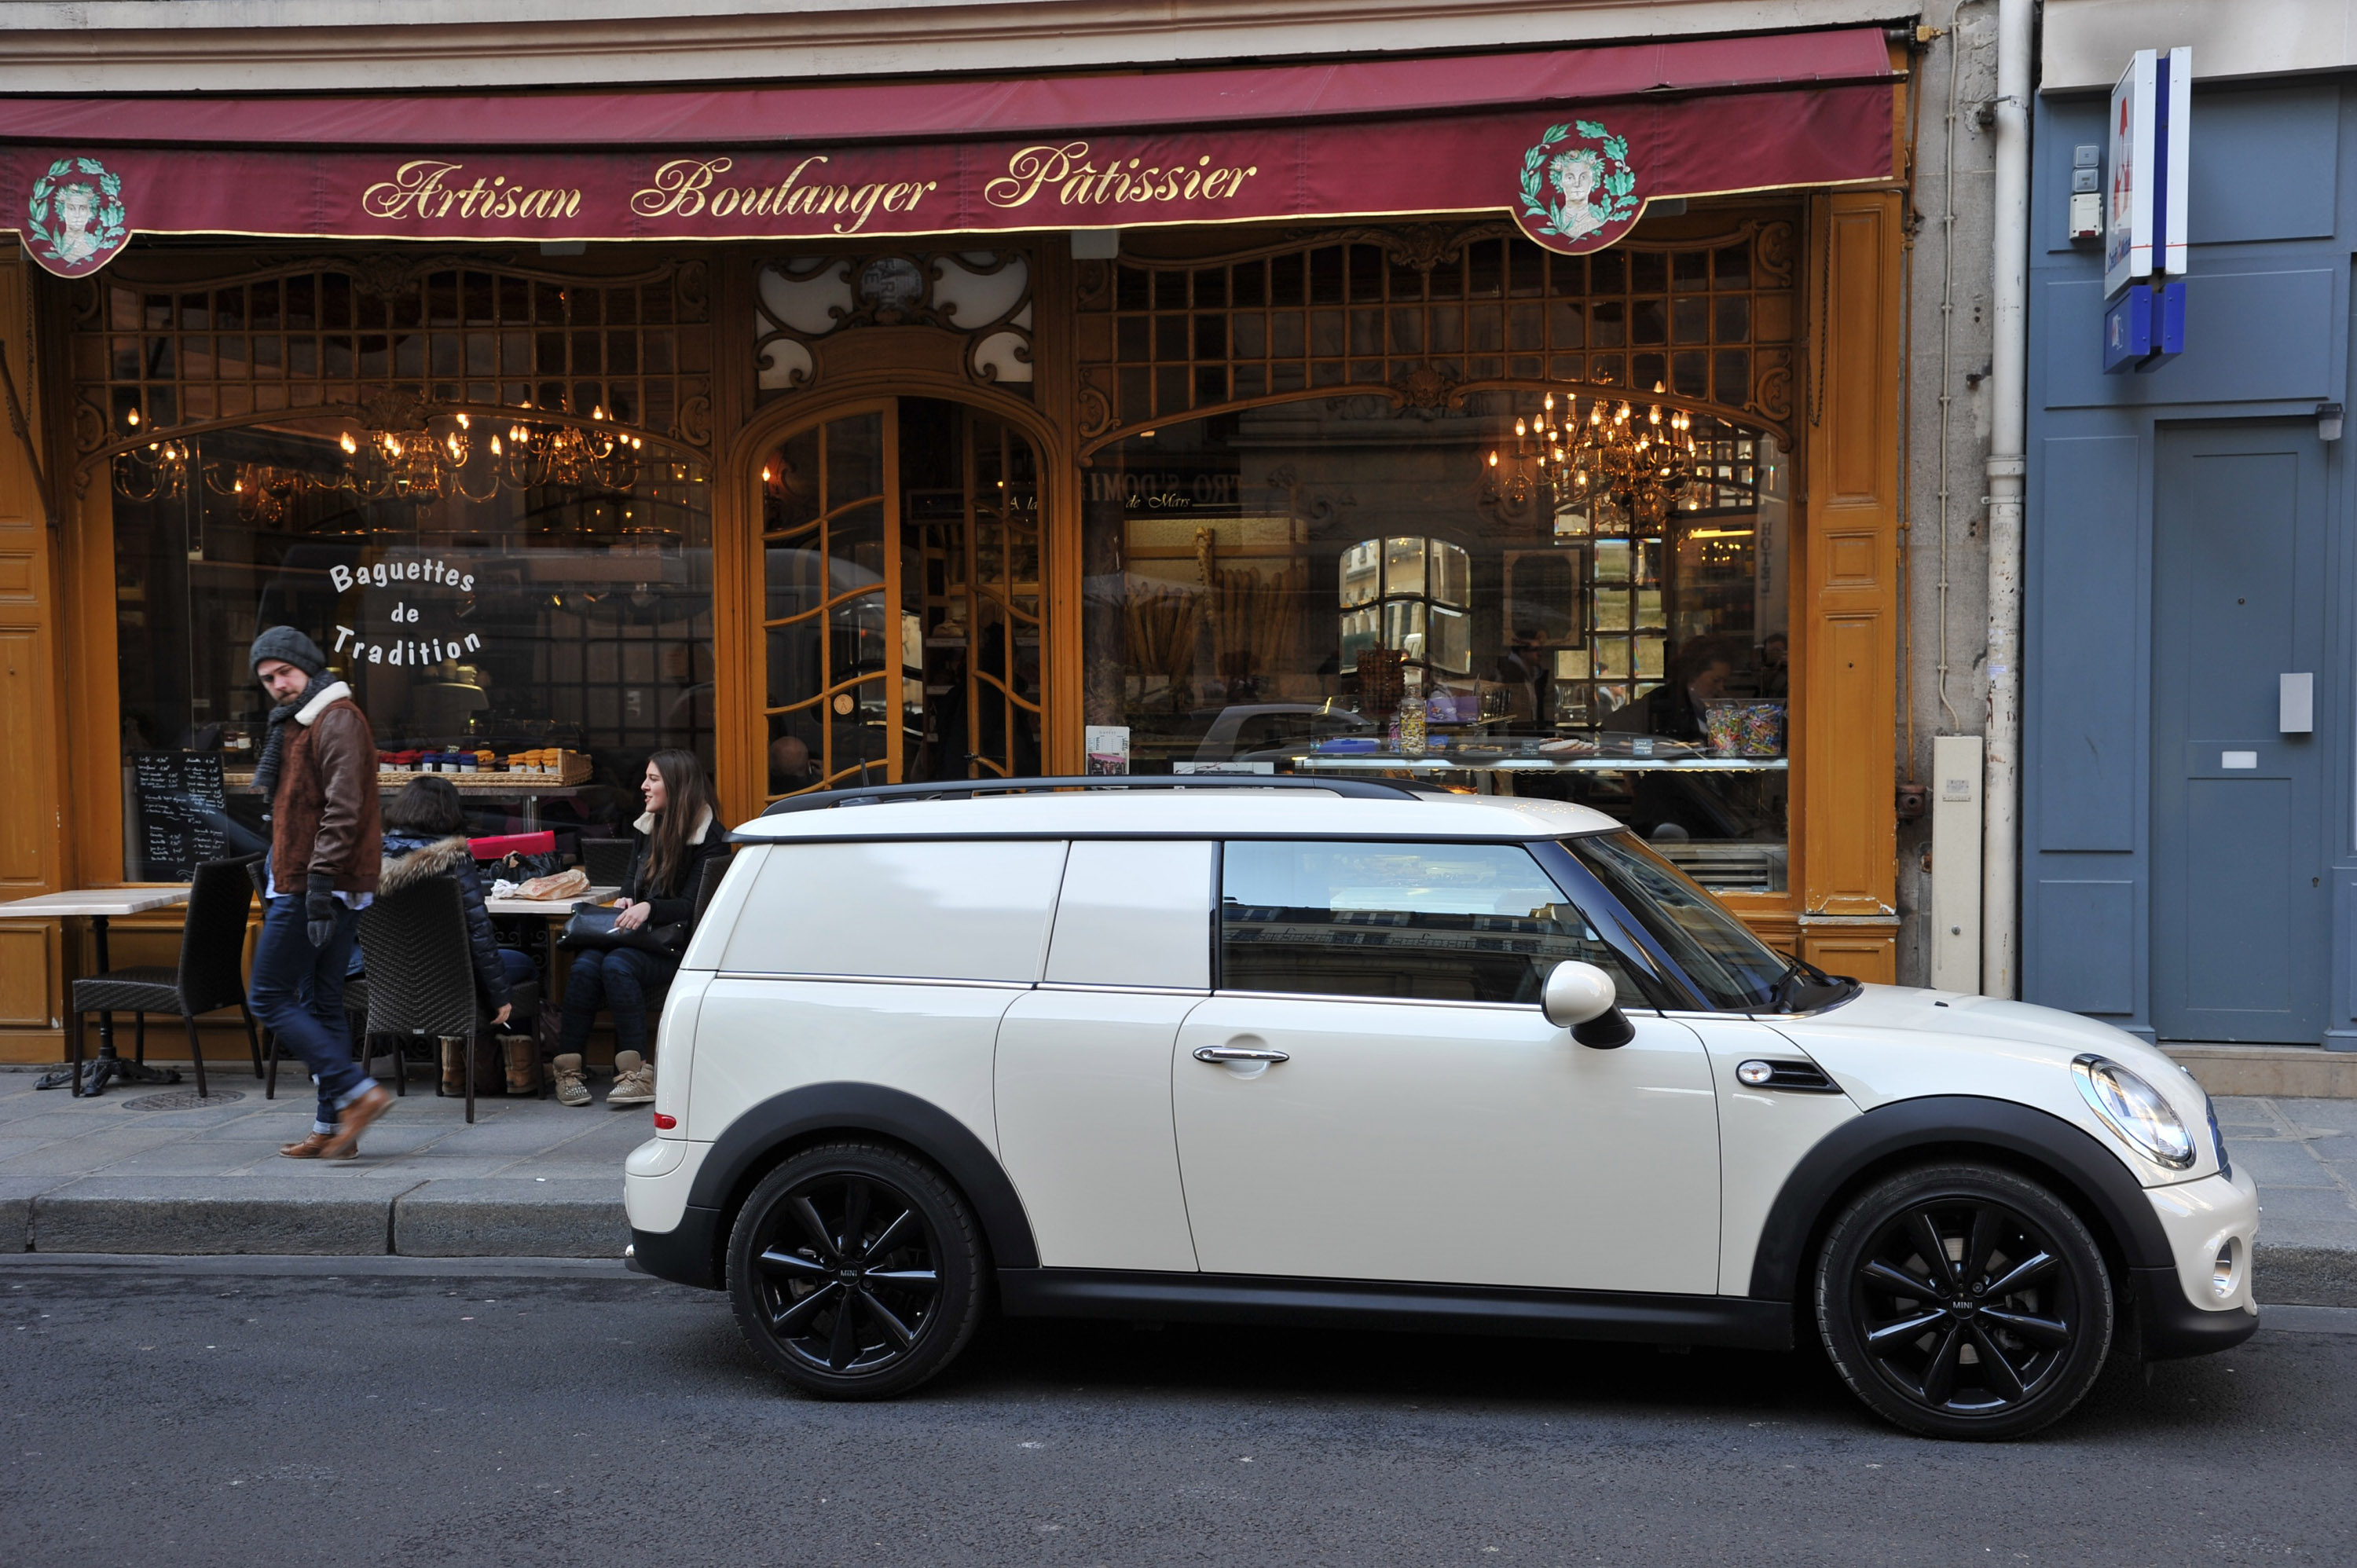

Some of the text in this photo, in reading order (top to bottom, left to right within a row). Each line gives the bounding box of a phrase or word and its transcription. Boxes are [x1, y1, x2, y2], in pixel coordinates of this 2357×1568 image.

[362, 141, 1258, 234] Artisan Boulanger Pâtissier
[1125, 494, 1141, 509] de
[1148, 493, 1191, 509] Mars
[329, 559, 475, 593] Baguettes
[390, 602, 420, 623] de
[334, 625, 481, 666] Tradition
